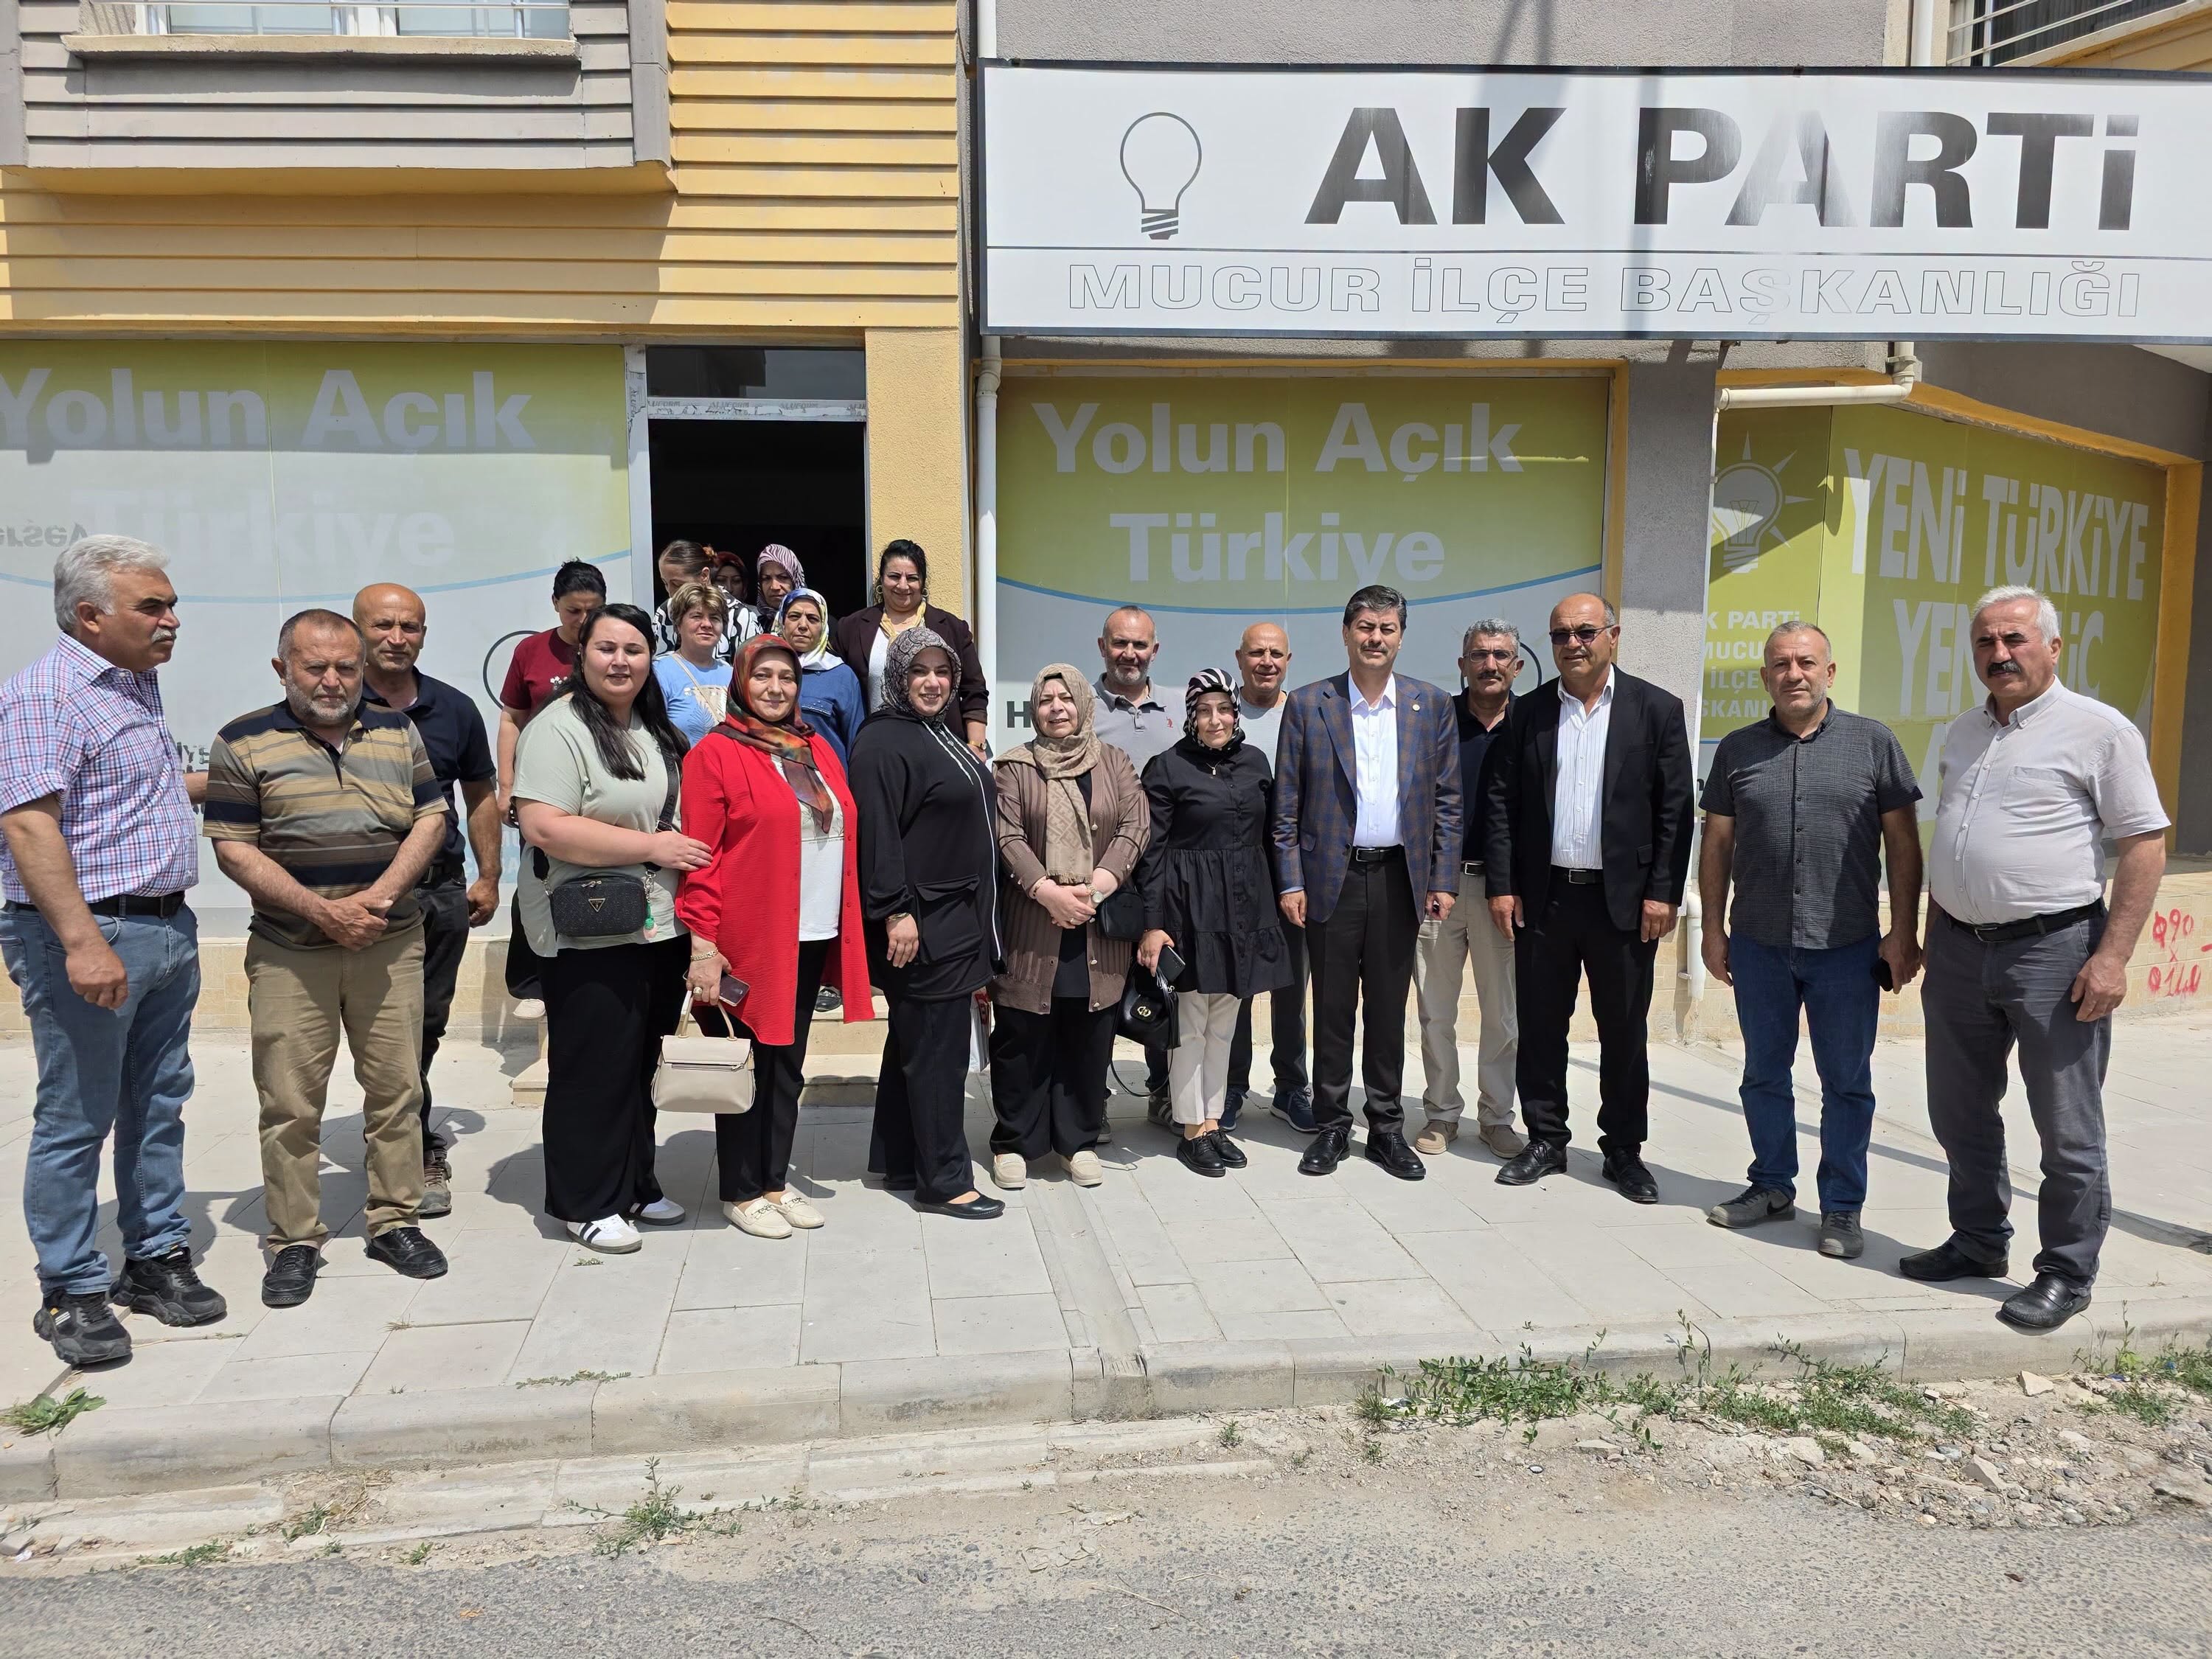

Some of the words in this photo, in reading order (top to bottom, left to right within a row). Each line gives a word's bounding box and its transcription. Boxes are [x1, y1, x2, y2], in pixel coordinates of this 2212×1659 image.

[1304, 107, 1567, 225] AK
[1069, 264, 1381, 312] MUCUR
[1411, 257, 1589, 324] İLÇE
[1621, 260, 2140, 325] BAŞKANLIĞI
[0, 368, 267, 445] Yolun
[1032, 403, 1284, 473] Yolun
[1315, 403, 1524, 482] Açık
[1110, 512, 1444, 586] Türkiye
[1704, 641, 1764, 660] MUCU
[1705, 611, 1719, 630] K
[1710, 666, 1759, 694] İLÇE
[1893, 599, 1990, 717] YEN
